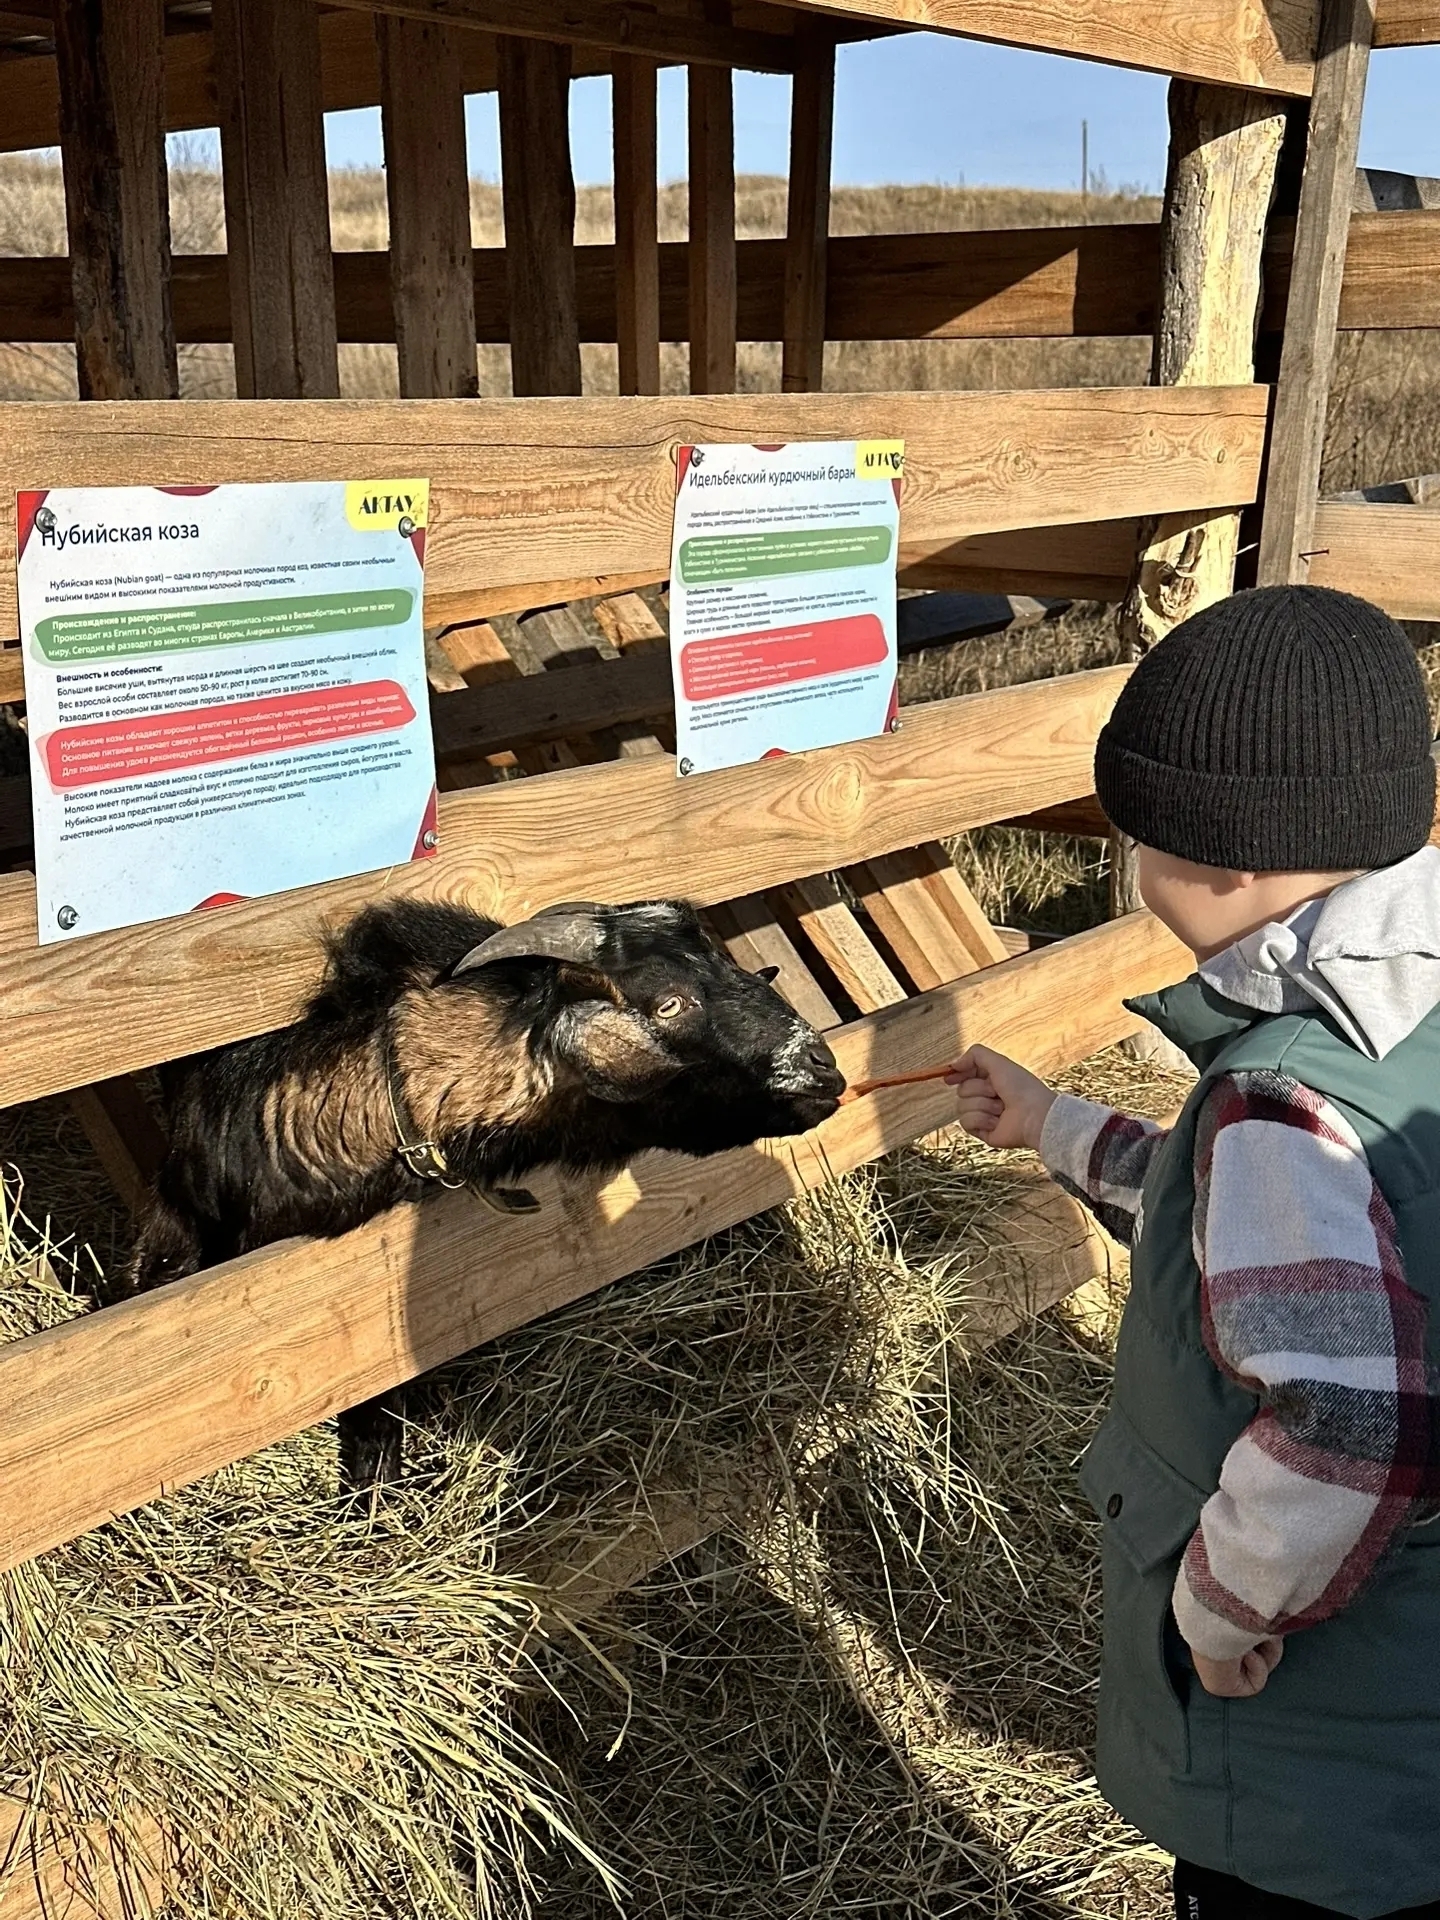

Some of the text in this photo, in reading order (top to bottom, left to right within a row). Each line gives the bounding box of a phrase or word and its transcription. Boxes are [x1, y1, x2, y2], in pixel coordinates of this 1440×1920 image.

[863, 452, 899, 470] АТА
[690, 466, 855, 487] Идельбекский курдючный баран
[42, 524, 199, 550] Нубийская коза
[144, 573, 164, 584] goat)
[56, 672, 102, 682] Внешность
[57, 686, 93, 696] Большие
[58, 701, 72, 709] Вес
[74, 695, 110, 707] взрослой
[112, 692, 135, 703] особи
[58, 711, 103, 722] Разводится
[63, 790, 98, 801] Высокие
[99, 783, 142, 795] показатели
[64, 804, 94, 814] Молоко
[96, 799, 119, 809] имеет
[64, 814, 107, 828] Нубийская
[108, 811, 125, 820] коза
[59, 824, 113, 841] качественной
[114, 818, 152, 831] молочной
